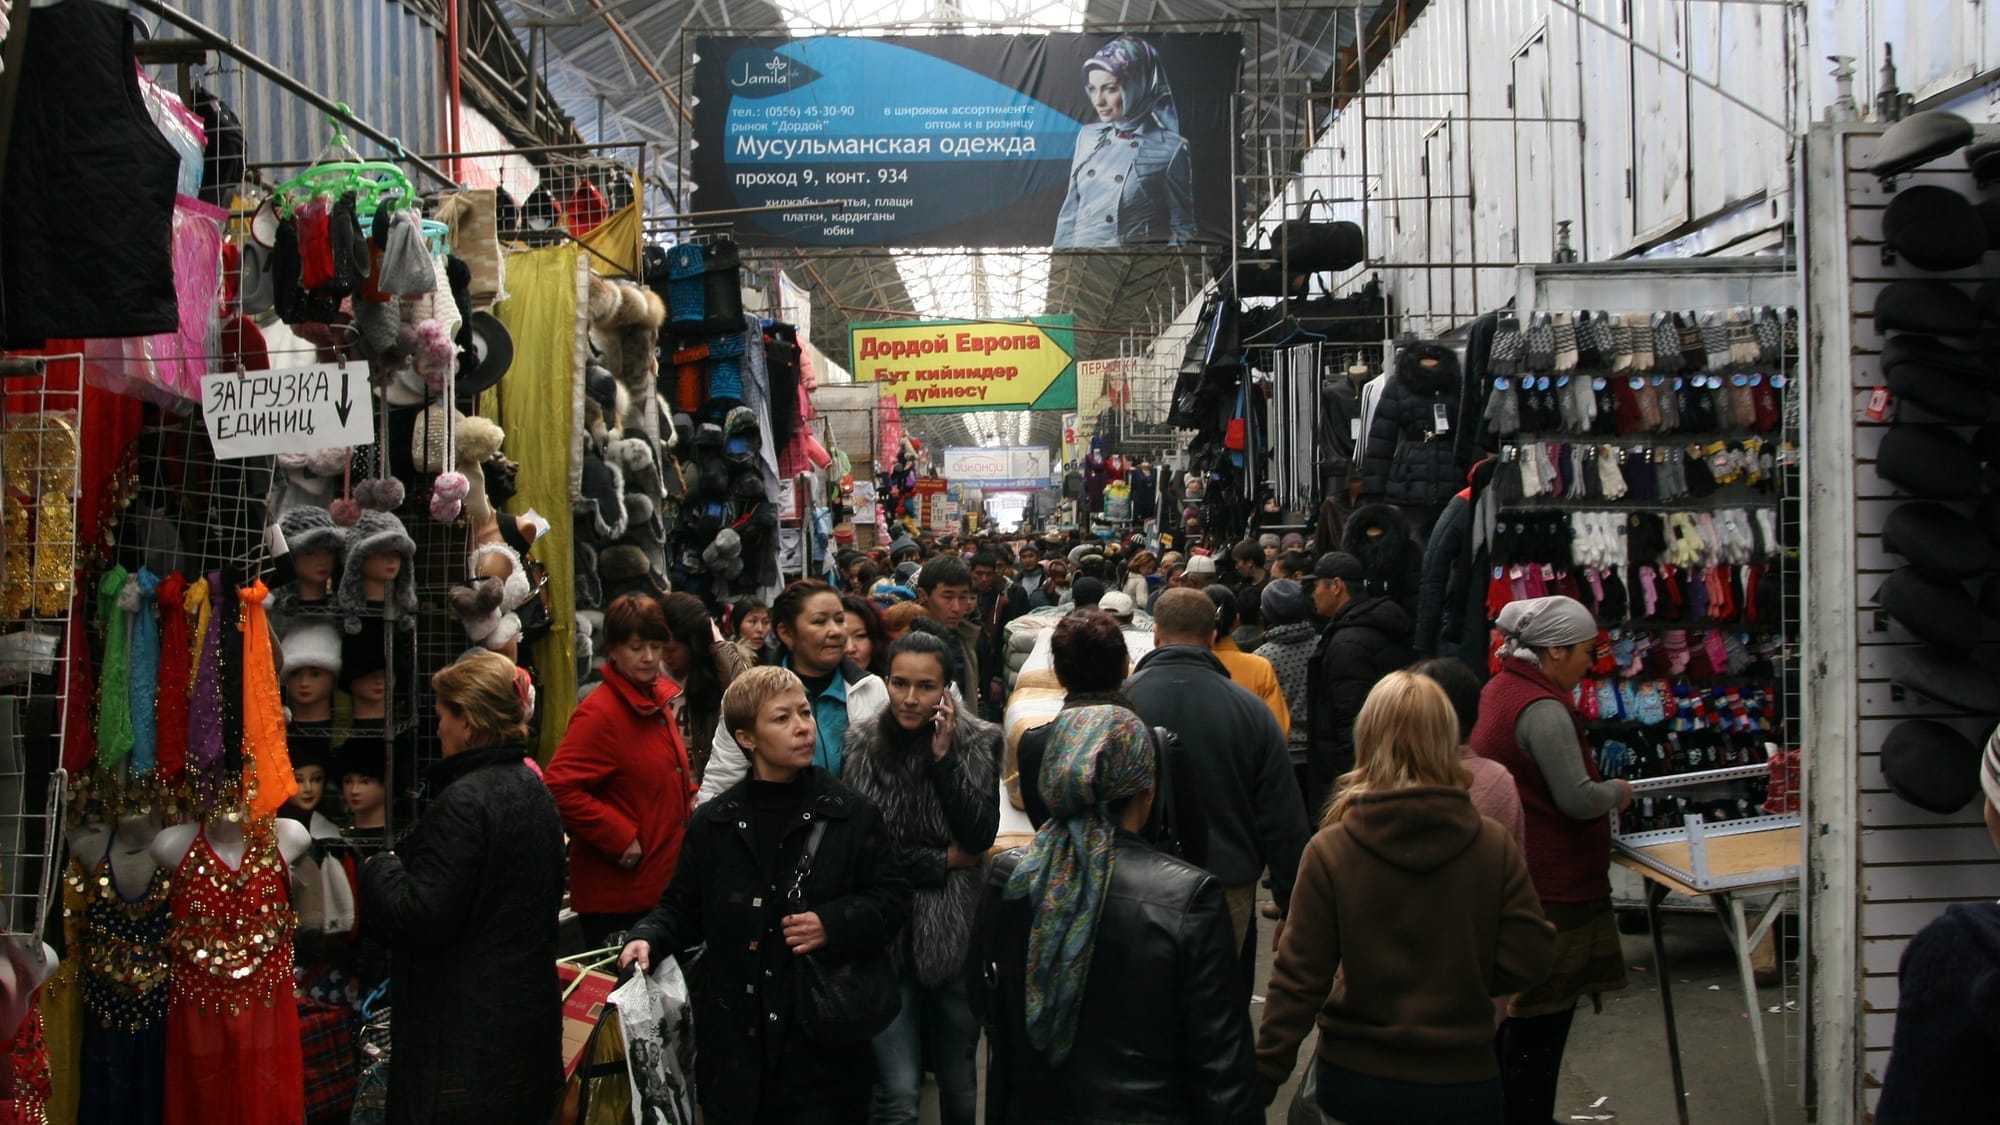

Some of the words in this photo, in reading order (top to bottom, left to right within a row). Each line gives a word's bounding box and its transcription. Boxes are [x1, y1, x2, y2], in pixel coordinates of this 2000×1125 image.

[731, 61, 787, 87] Jamila
[732, 106, 761, 117] тел.:
[765, 105, 801, 118] (0556)
[804, 105, 855, 117] 45-30-90
[883, 107, 892, 115] в
[895, 106, 948, 117] широком
[951, 104, 1035, 117] ассортименте
[731, 122, 768, 133] рынок
[924, 120, 960, 130] оптом
[964, 121, 972, 129] и
[975, 121, 983, 129] в
[986, 119, 1035, 130] розницу
[735, 135, 931, 160] Мусульманская
[939, 135, 1036, 157] одежда
[735, 170, 798, 188] проход
[802, 169, 819, 186] 9,
[825, 172, 871, 184] конт.
[877, 168, 908, 183] 934
[874, 198, 913, 208] плащи
[782, 212, 828, 222] платки,
[831, 211, 895, 223] кардиганы
[823, 225, 854, 236] юбки
[859, 333, 949, 360] Дордой
[955, 332, 1041, 356] Европа
[207, 371, 329, 414] ЗАГРУЗКА
[217, 408, 315, 441] ЕДИНИЦ
